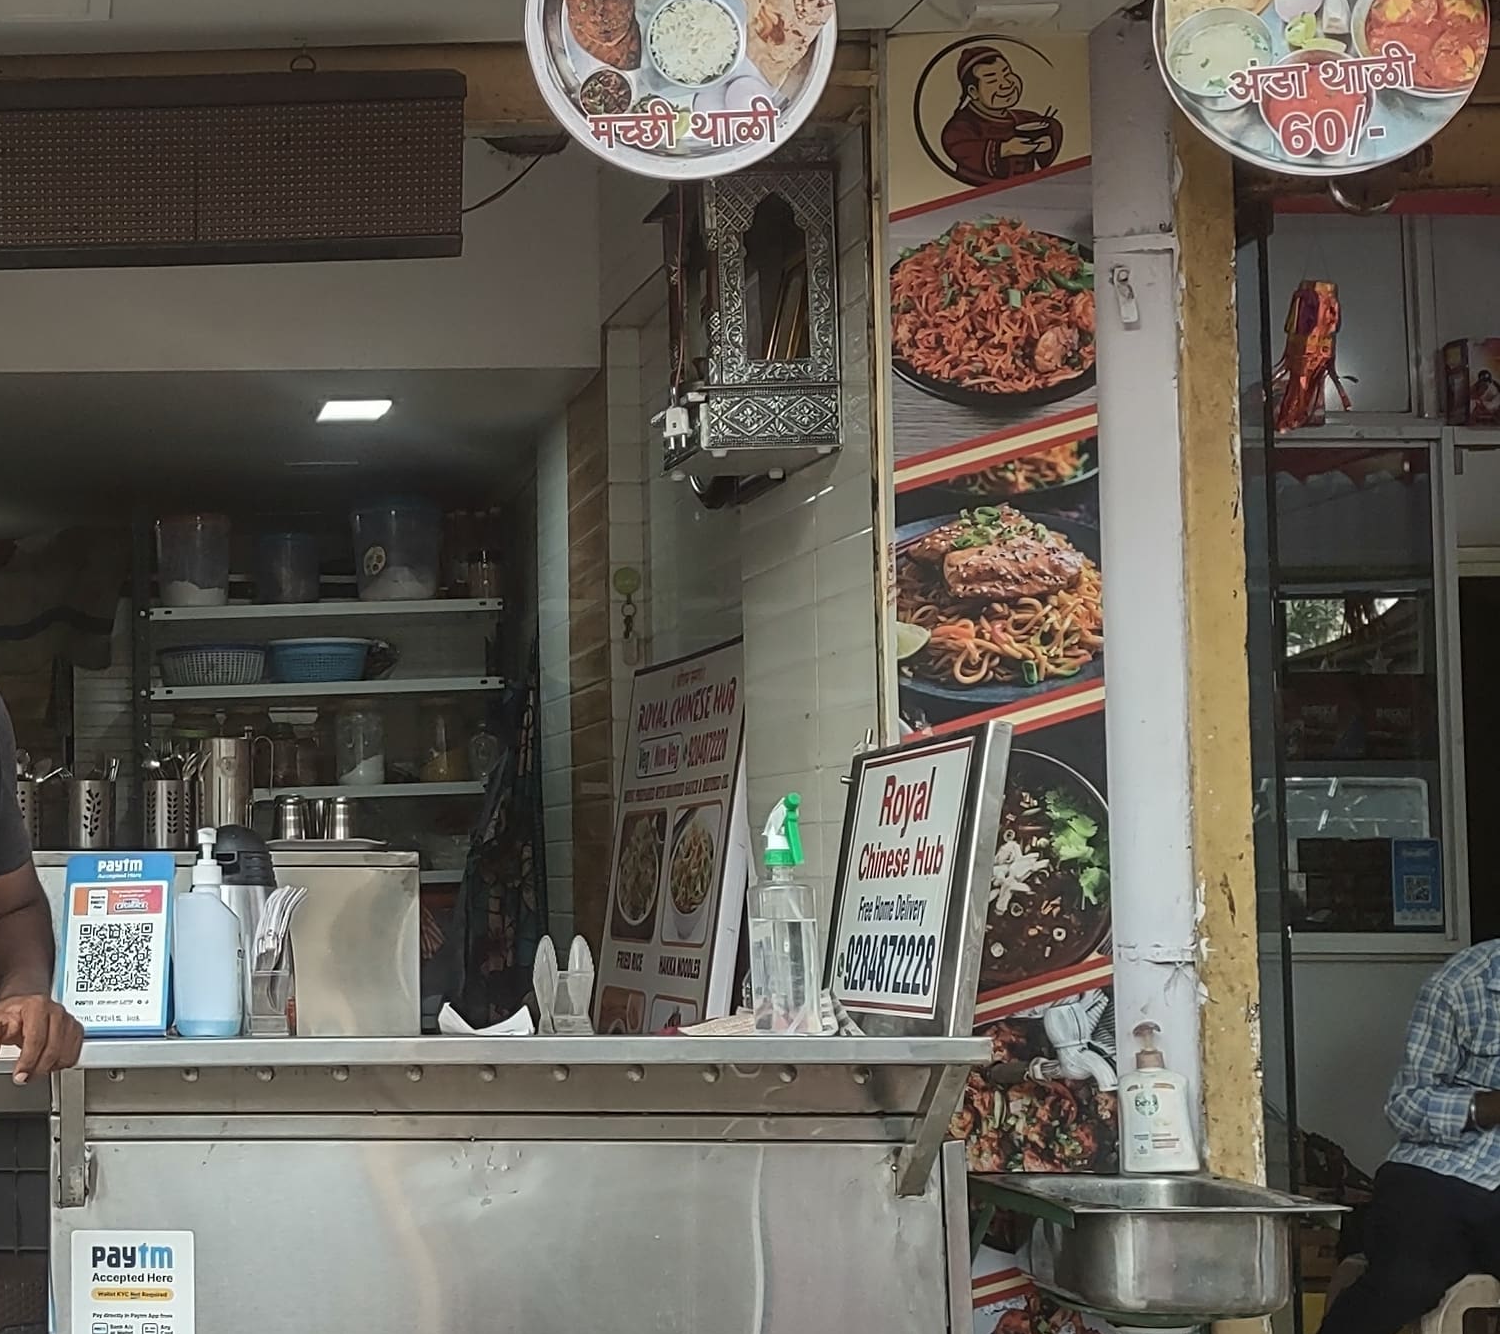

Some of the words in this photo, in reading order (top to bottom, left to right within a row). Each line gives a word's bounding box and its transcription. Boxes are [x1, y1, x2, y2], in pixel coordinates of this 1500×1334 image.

[1228, 58, 1308, 103] अंडा
[1319, 41, 1416, 95] थाळी
[588, 97, 679, 150] मच्छी
[690, 95, 780, 146] थाळी
[1279, 104, 1387, 157] 60/-
[878, 766, 938, 838] Royal
[857, 842, 911, 882] Chinese
[915, 834, 946, 877] Hub
[857, 895, 874, 924] Free
[874, 895, 894, 923] Home
[894, 892, 928, 927] Delivery
[842, 933, 937, 998] 9284872228
[92, 1272, 145, 1285] Accepted
[147, 1273, 174, 1283] Here
